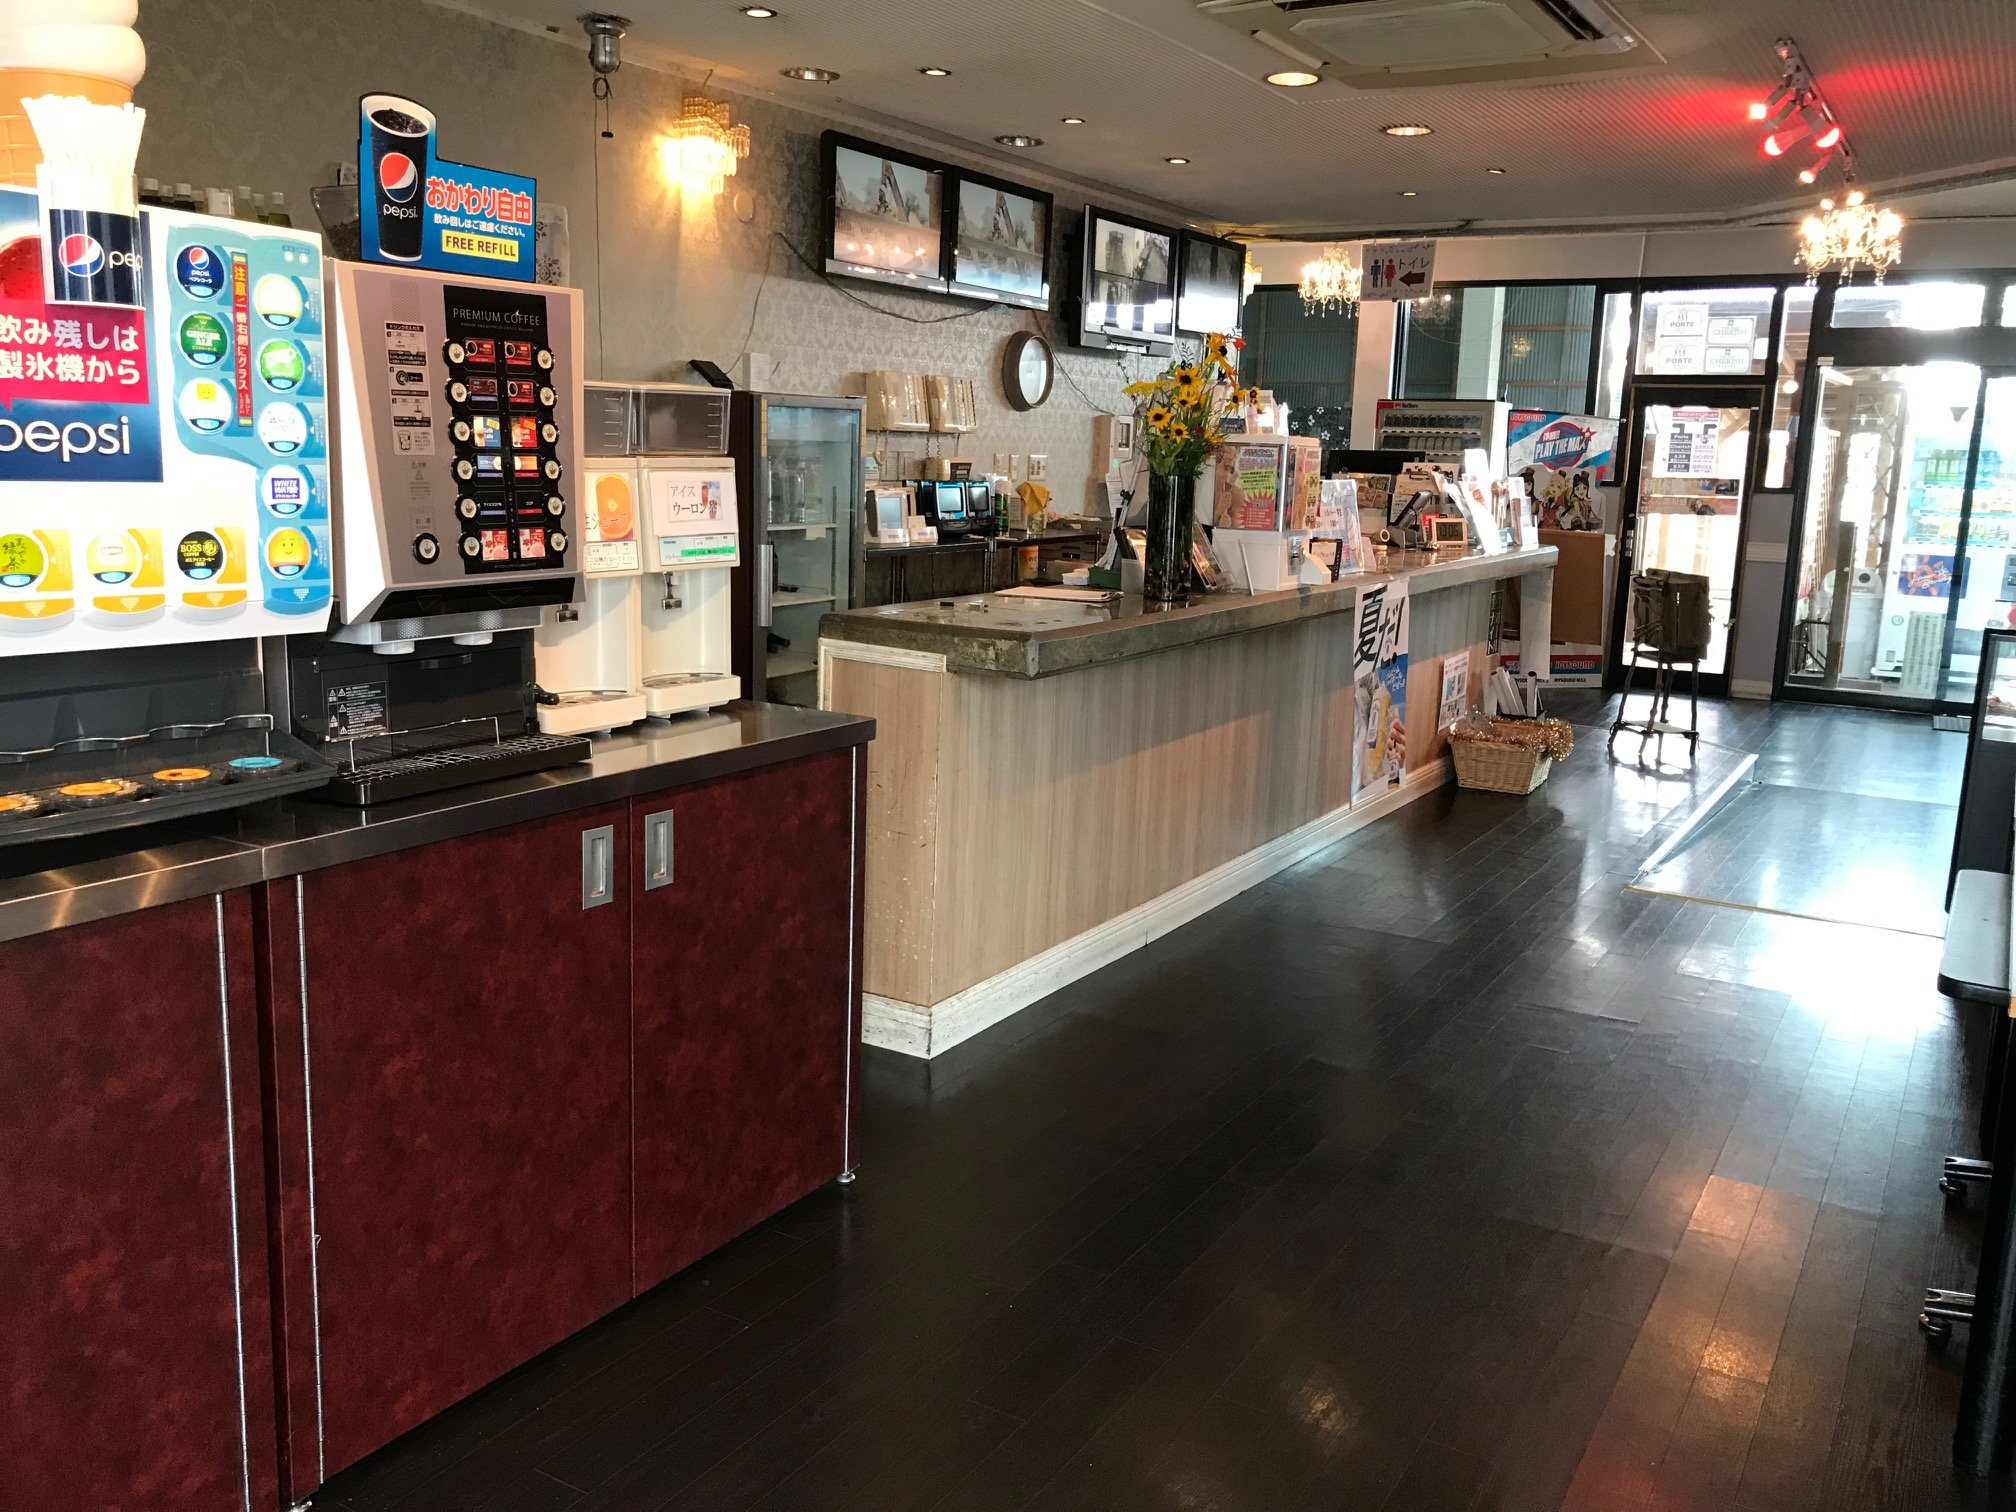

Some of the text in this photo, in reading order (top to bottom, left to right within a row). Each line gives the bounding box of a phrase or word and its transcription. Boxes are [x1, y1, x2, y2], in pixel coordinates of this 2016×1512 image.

[426, 176, 532, 225] おかわり自由
[383, 204, 417, 219] pepsi
[445, 236, 516, 257] FREE REFILL
[1399, 257, 1430, 271] トイレ
[453, 308, 540, 326] PREMIUM COFFEE
[0, 314, 139, 352] 飲み残しは
[186, 330, 220, 340] GINGER
[0, 350, 140, 384] 製氷機から
[1536, 441, 1554, 459] PLAY
[1555, 438, 1568, 455] THE
[671, 485, 696, 498] アイス
[180, 544, 202, 552] BOSS
[1555, 661, 1595, 669] JOYSOUND
